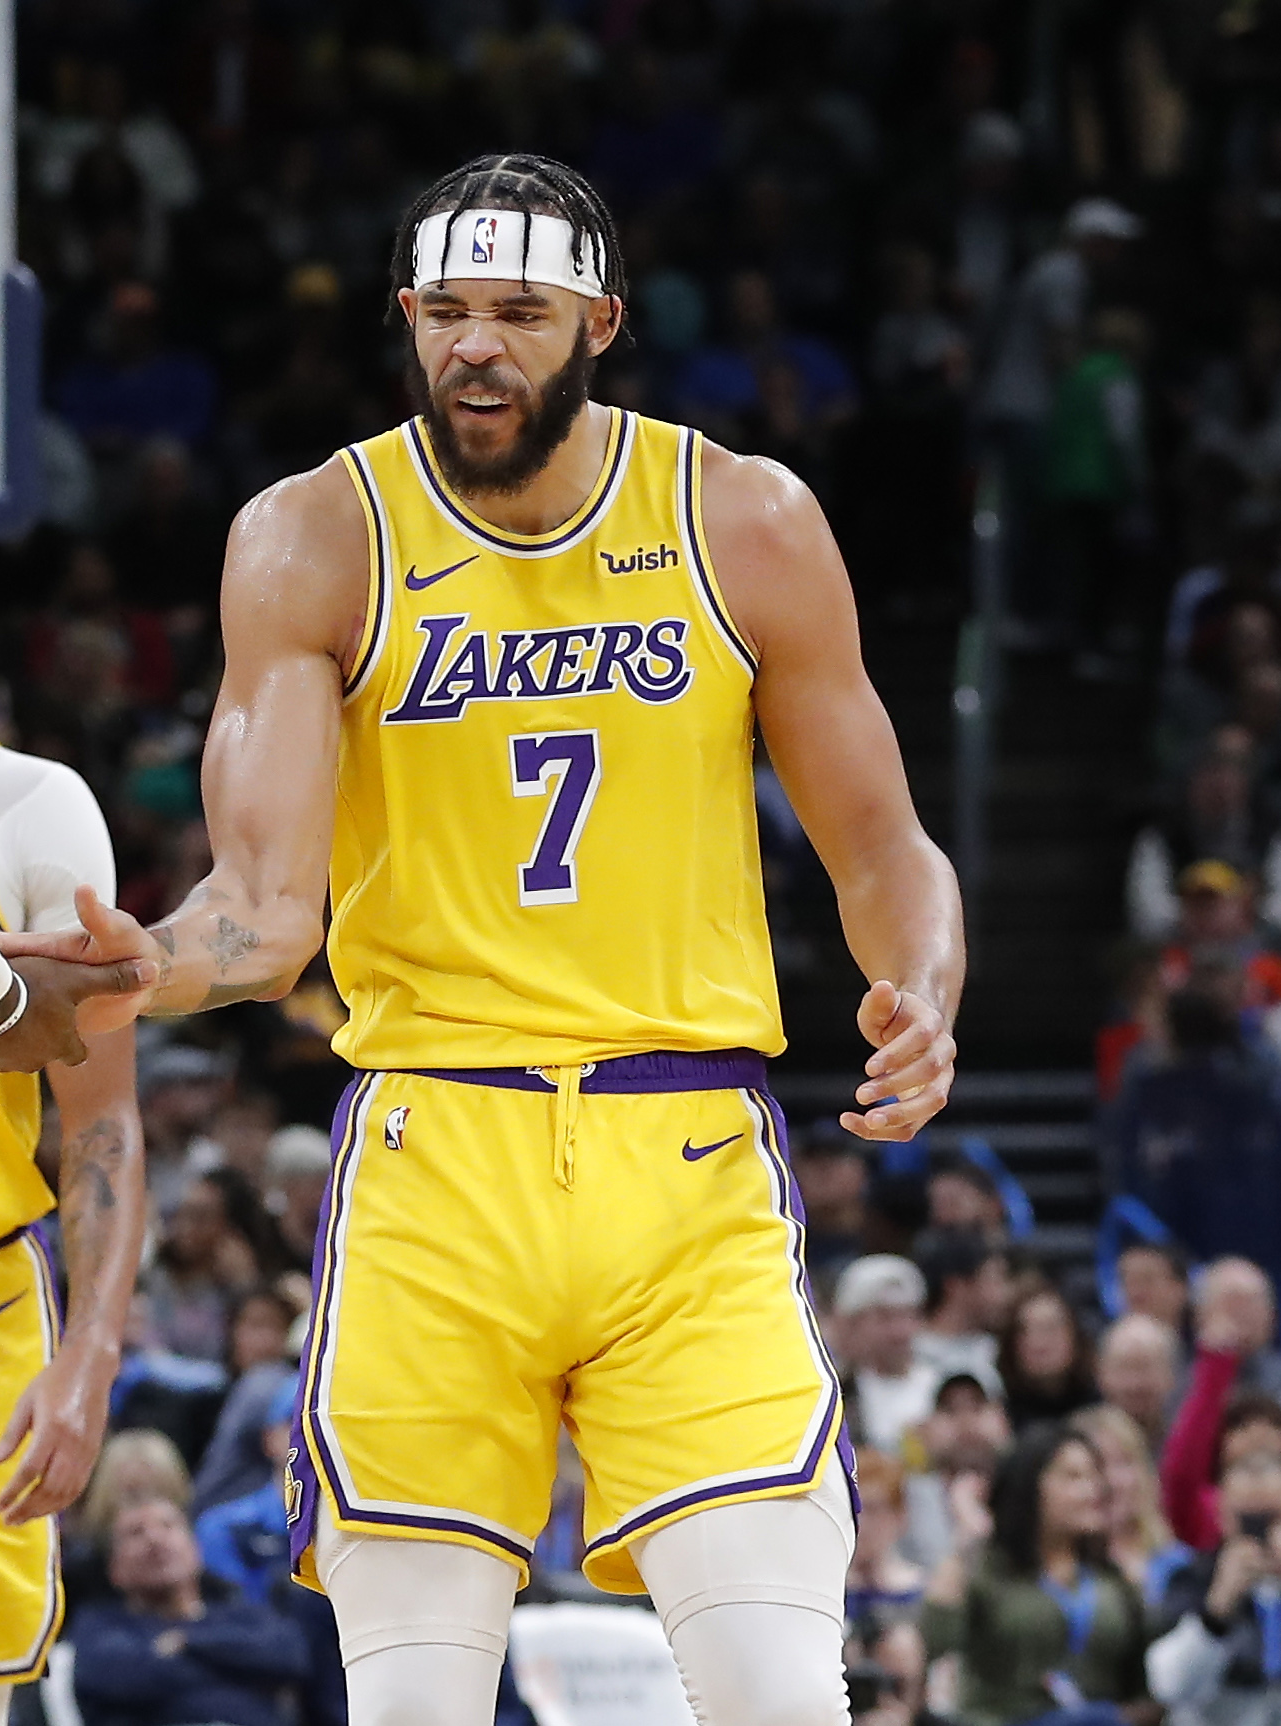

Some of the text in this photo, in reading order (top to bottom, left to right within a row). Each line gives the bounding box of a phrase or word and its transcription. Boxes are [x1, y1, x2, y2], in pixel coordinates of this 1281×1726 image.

[600, 543, 679, 575] wish
[380, 612, 696, 726] LAKERS
[508, 728, 603, 907] 7
